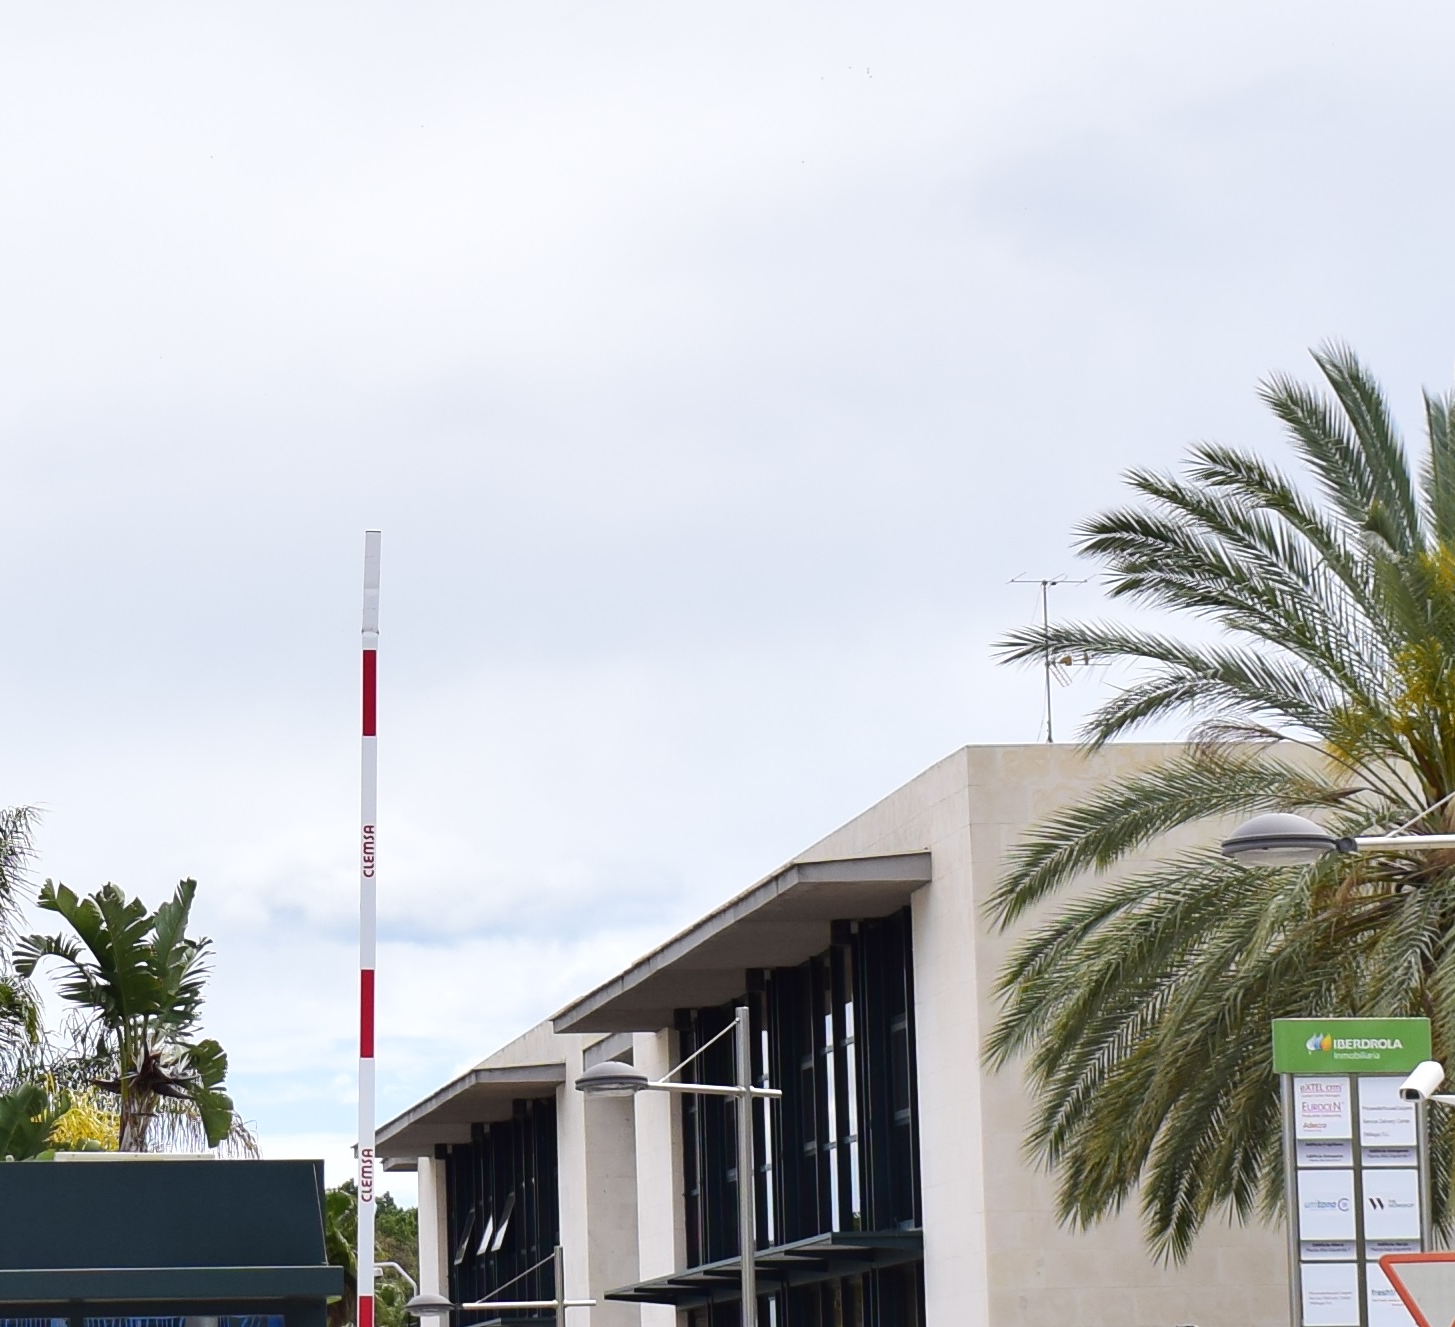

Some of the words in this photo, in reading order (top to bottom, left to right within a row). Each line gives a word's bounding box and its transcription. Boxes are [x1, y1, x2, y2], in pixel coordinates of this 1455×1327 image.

[363, 824, 375, 878] CLEMSA
[1333, 1038, 1403, 1050] IBERDROLA
[361, 1148, 373, 1203] CLEMSA
